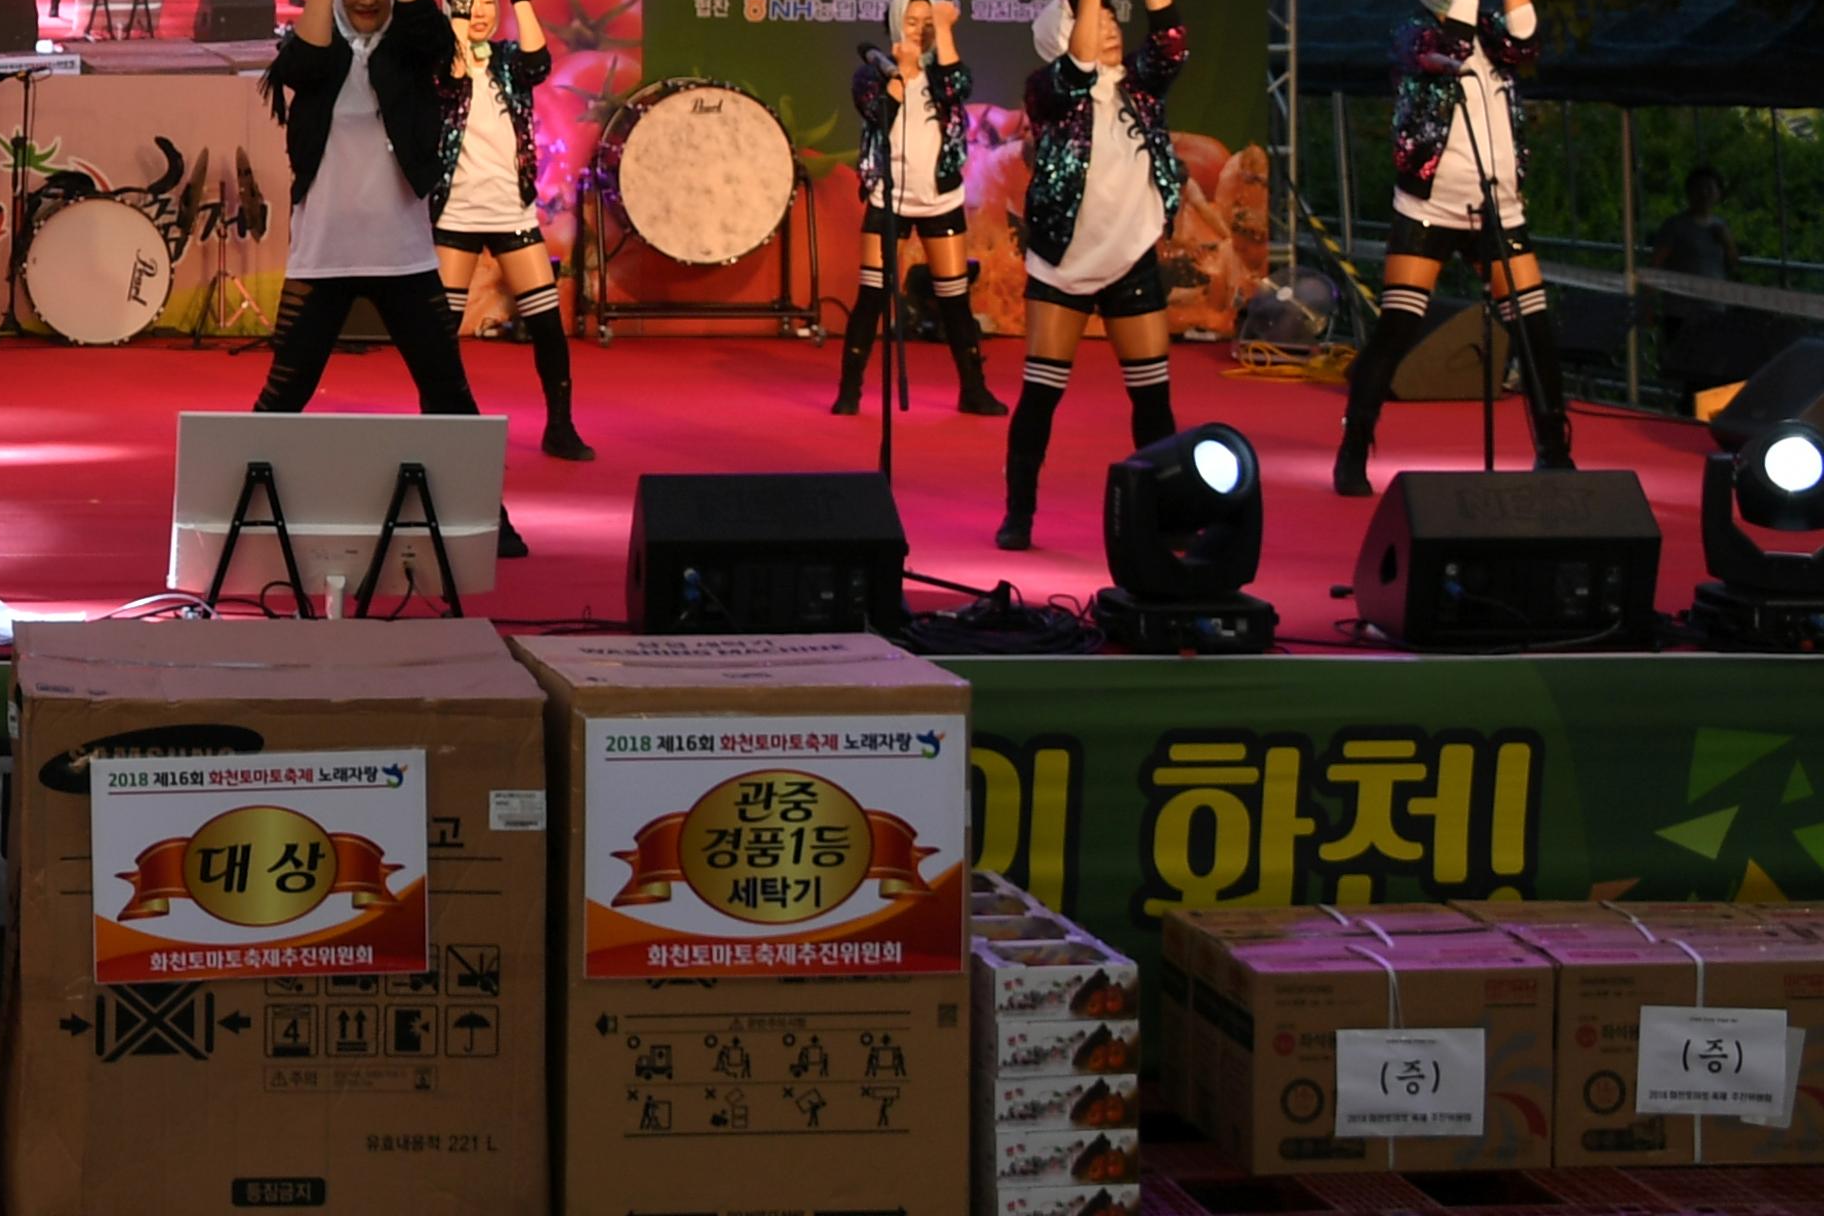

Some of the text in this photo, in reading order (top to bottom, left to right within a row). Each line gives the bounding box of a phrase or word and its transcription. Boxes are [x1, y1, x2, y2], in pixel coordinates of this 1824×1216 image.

[606, 733, 912, 752] 2018 제16회 화천토마토축제 노래자랑
[108, 765, 377, 787] 2018 제16회 화천토마토축제 노래자랑
[733, 780, 820, 824] 관중
[700, 825, 852, 869] 경품1등
[726, 875, 823, 911] 세탁기
[150, 945, 373, 972] 화천토마토축제추진위원회
[647, 942, 903, 968] 화천토마토축제추진위원회
[1682, 1039, 1743, 1073] (증)
[1381, 1060, 1440, 1095] (증)
